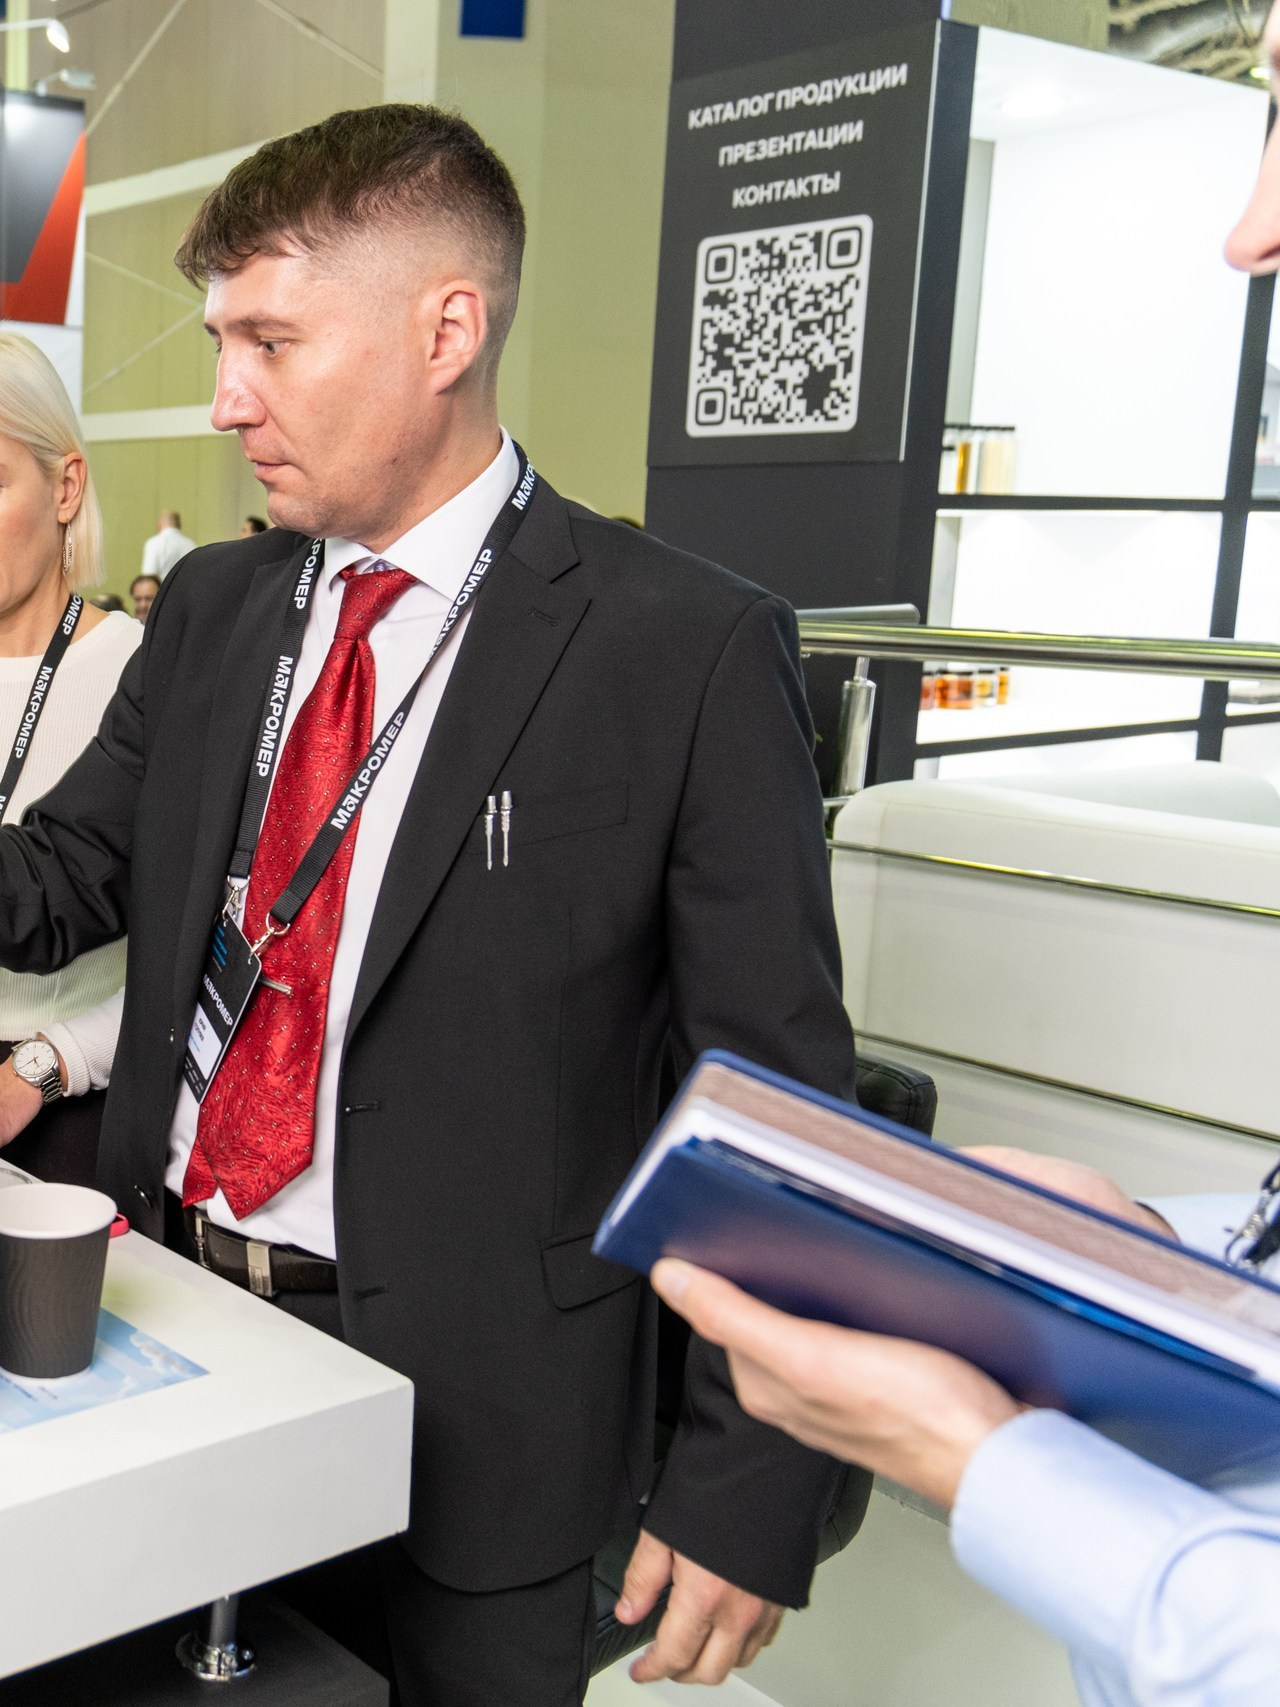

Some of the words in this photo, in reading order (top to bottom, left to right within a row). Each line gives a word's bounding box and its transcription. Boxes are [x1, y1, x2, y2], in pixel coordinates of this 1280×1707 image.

[687, 92, 775, 130] КАТАЛОГ
[775, 63, 908, 111] ПРОДУКЦИИ
[718, 120, 864, 167] ПРЕЗЕНТАЦИИ
[732, 171, 841, 209] КОНТАКТЫ
